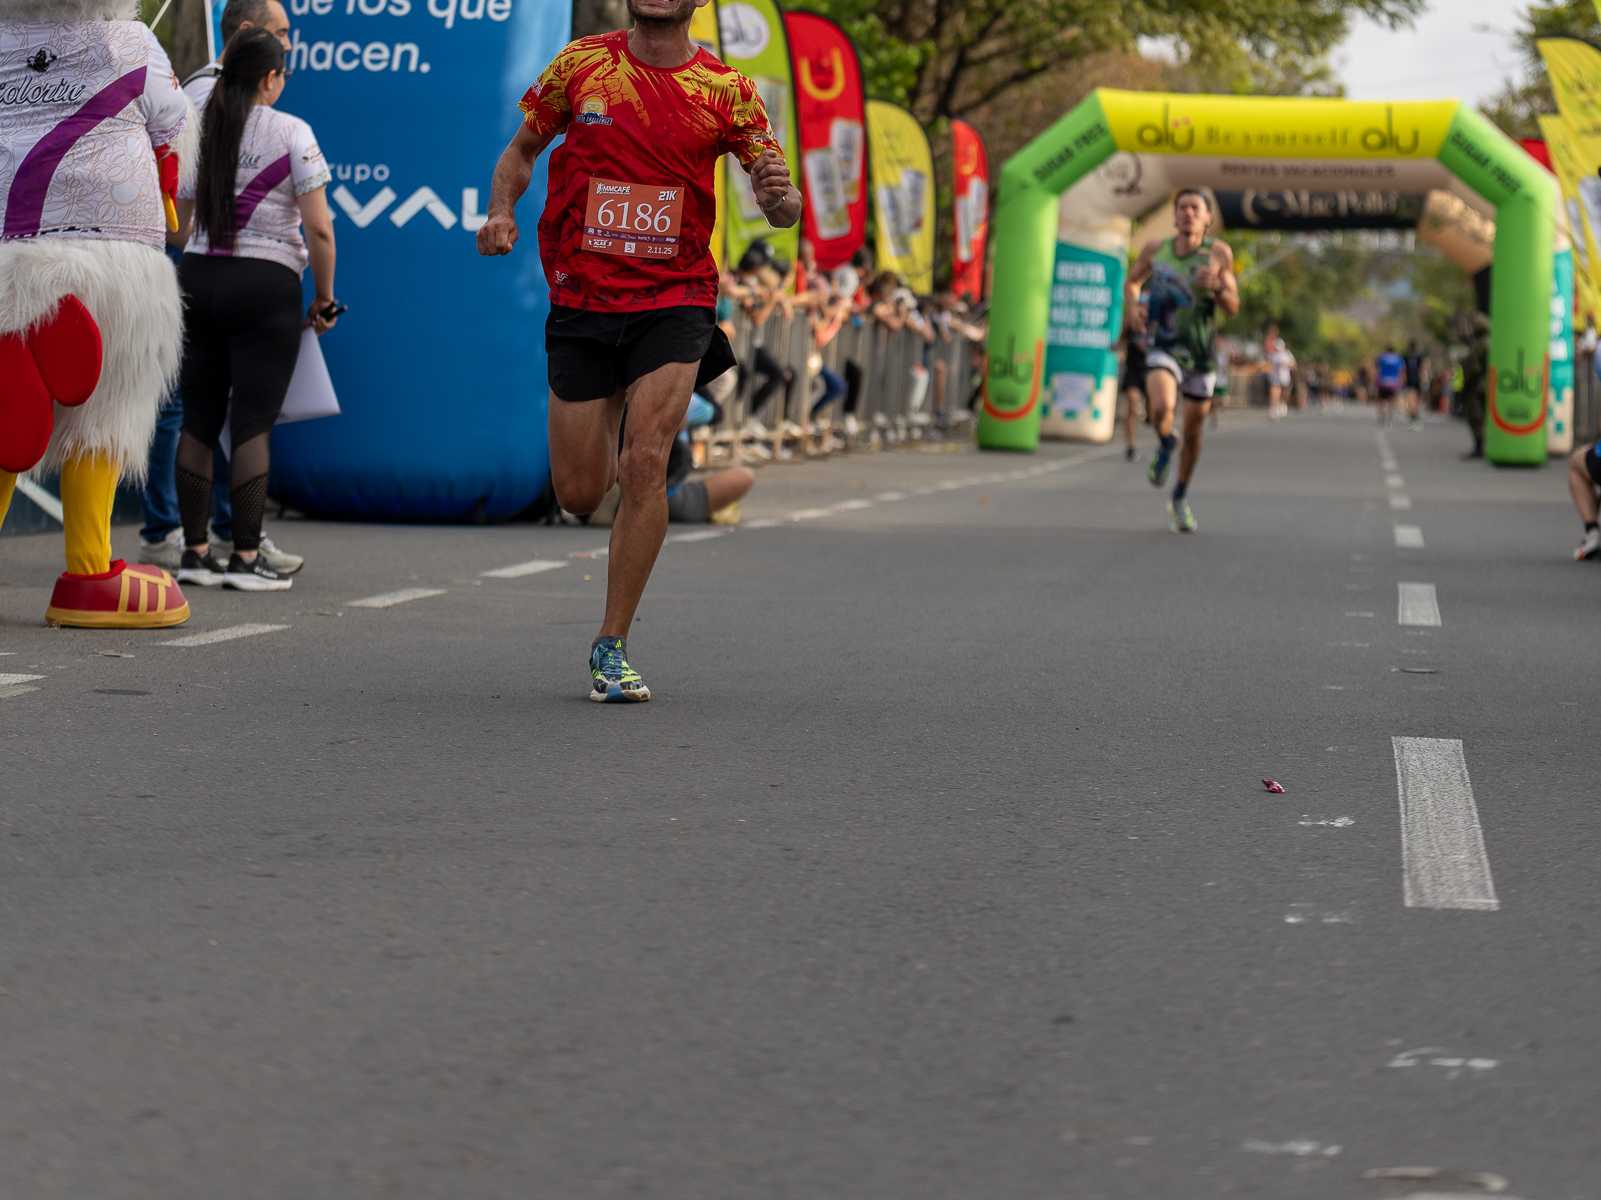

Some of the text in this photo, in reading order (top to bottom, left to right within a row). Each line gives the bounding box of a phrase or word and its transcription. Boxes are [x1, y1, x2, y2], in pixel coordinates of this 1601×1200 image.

[290, 29, 431, 73] hacen.
[658, 190, 678, 202] 21K
[597, 199, 672, 233] 6186
[647, 246, 673, 255] 2.11.25
